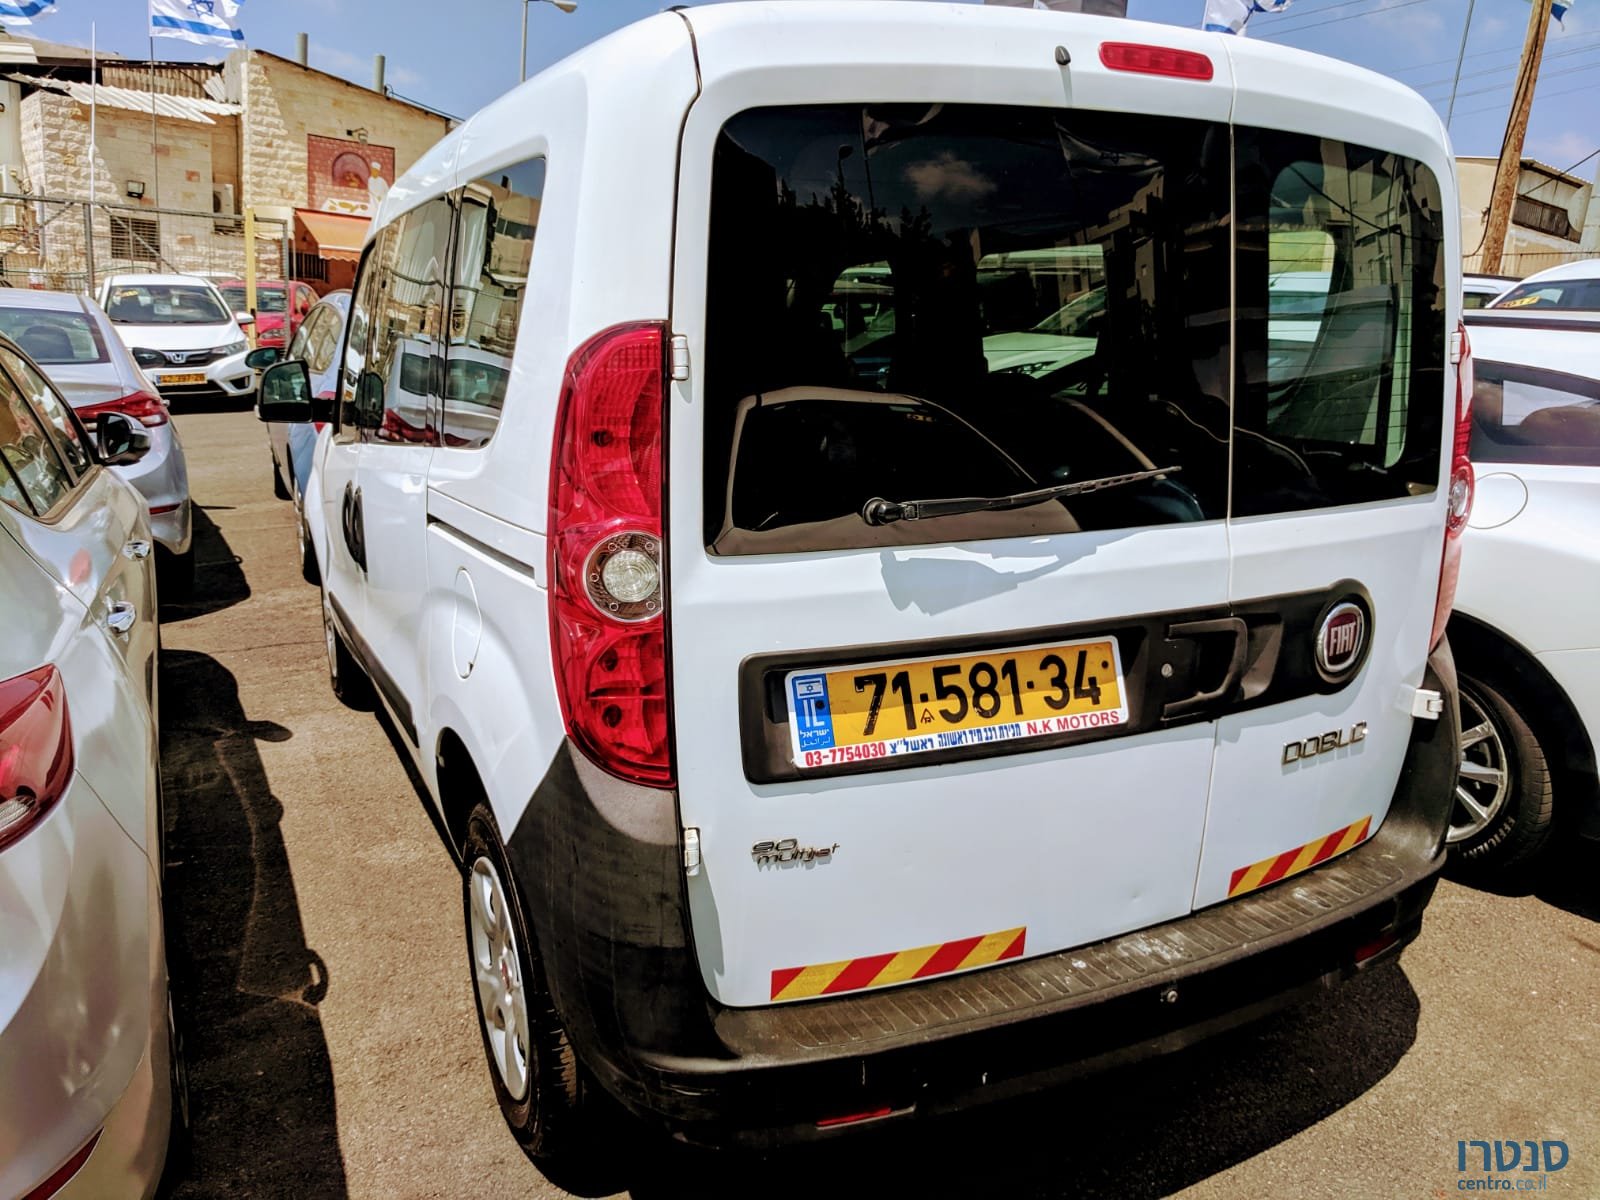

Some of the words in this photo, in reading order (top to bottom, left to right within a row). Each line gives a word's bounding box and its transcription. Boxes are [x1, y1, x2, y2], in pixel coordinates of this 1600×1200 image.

[1329, 622, 1357, 656] FIAT
[803, 698, 825, 728] IL
[1026, 718, 1053, 735] N.K
[1057, 711, 1120, 731] MOTORS
[800, 729, 830, 738] ישראל
[938, 730, 968, 747] ראשונה
[969, 728, 983, 743] מיד
[805, 742, 886, 766] 03-7754030
